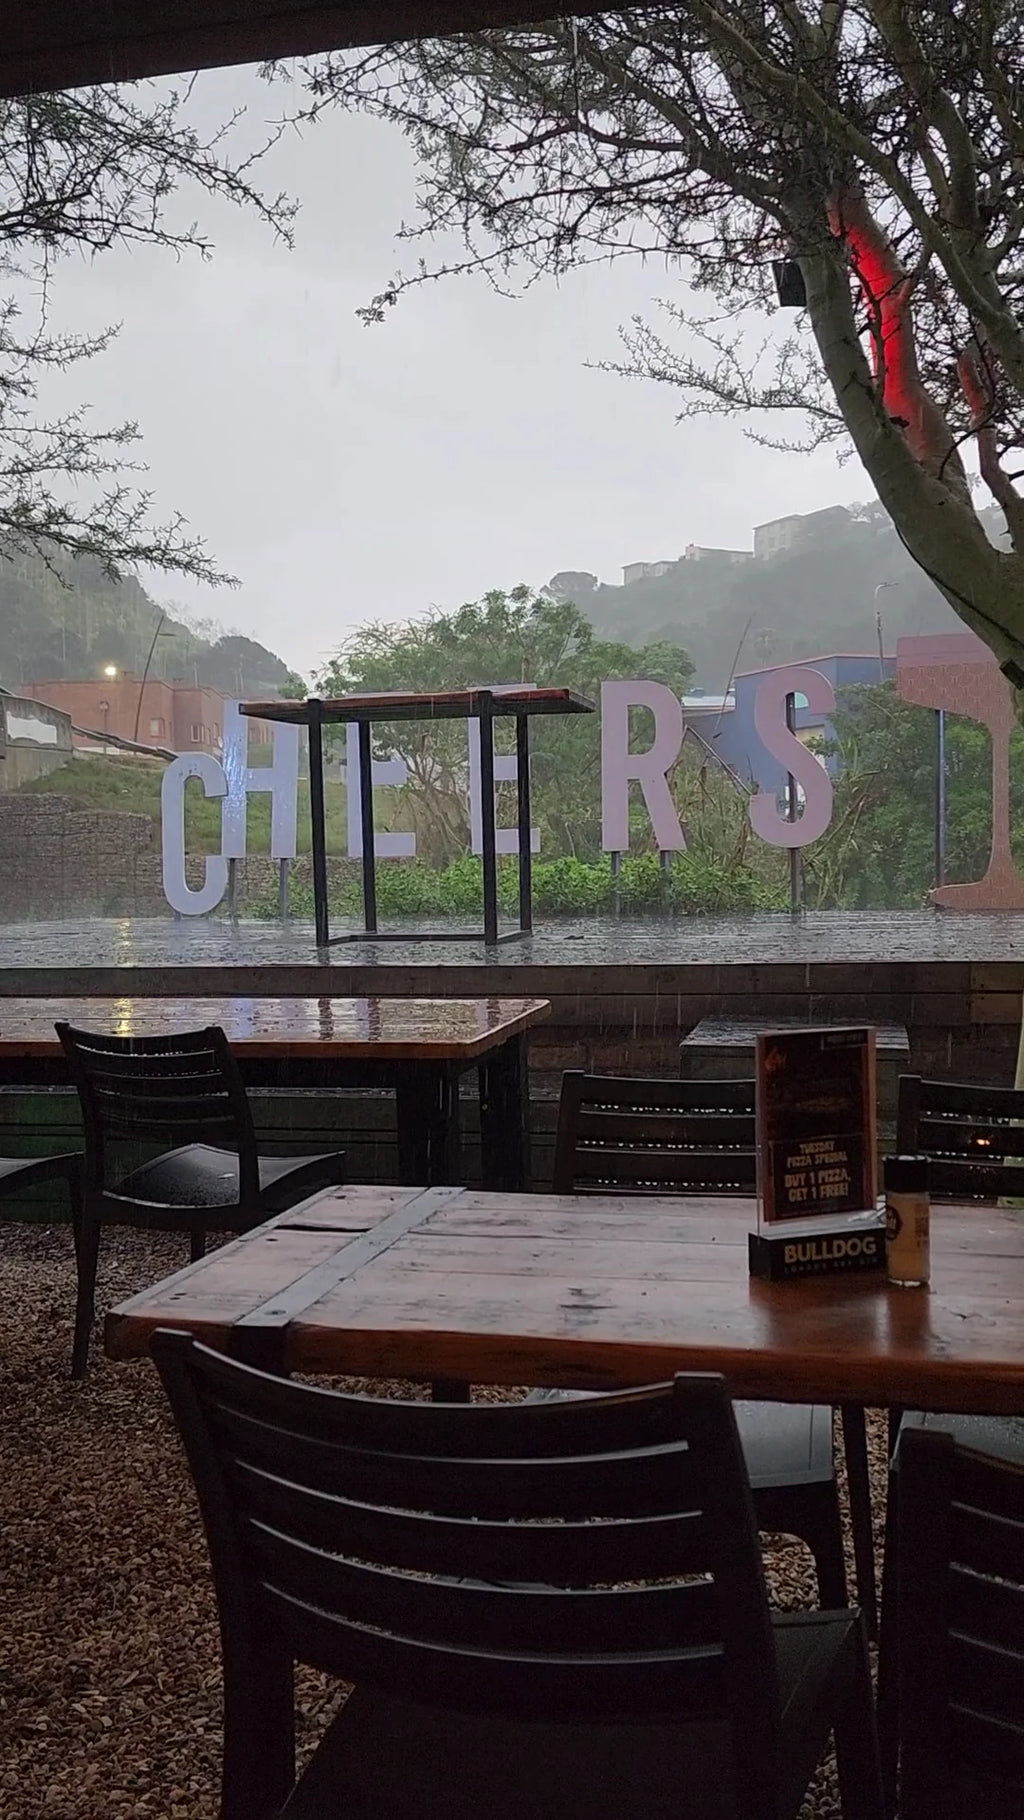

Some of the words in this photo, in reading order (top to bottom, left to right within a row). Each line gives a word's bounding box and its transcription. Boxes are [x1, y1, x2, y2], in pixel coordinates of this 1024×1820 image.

[161, 666, 836, 915] CHEERS
[786, 1155, 813, 1168] PIZZA
[784, 1172, 806, 1188] BUY
[809, 1171, 815, 1184] 1
[788, 1186, 809, 1202] GET
[811, 1186, 817, 1199] 1
[819, 1182, 849, 1198] FREE!
[784, 1236, 877, 1264] BULLDOG
